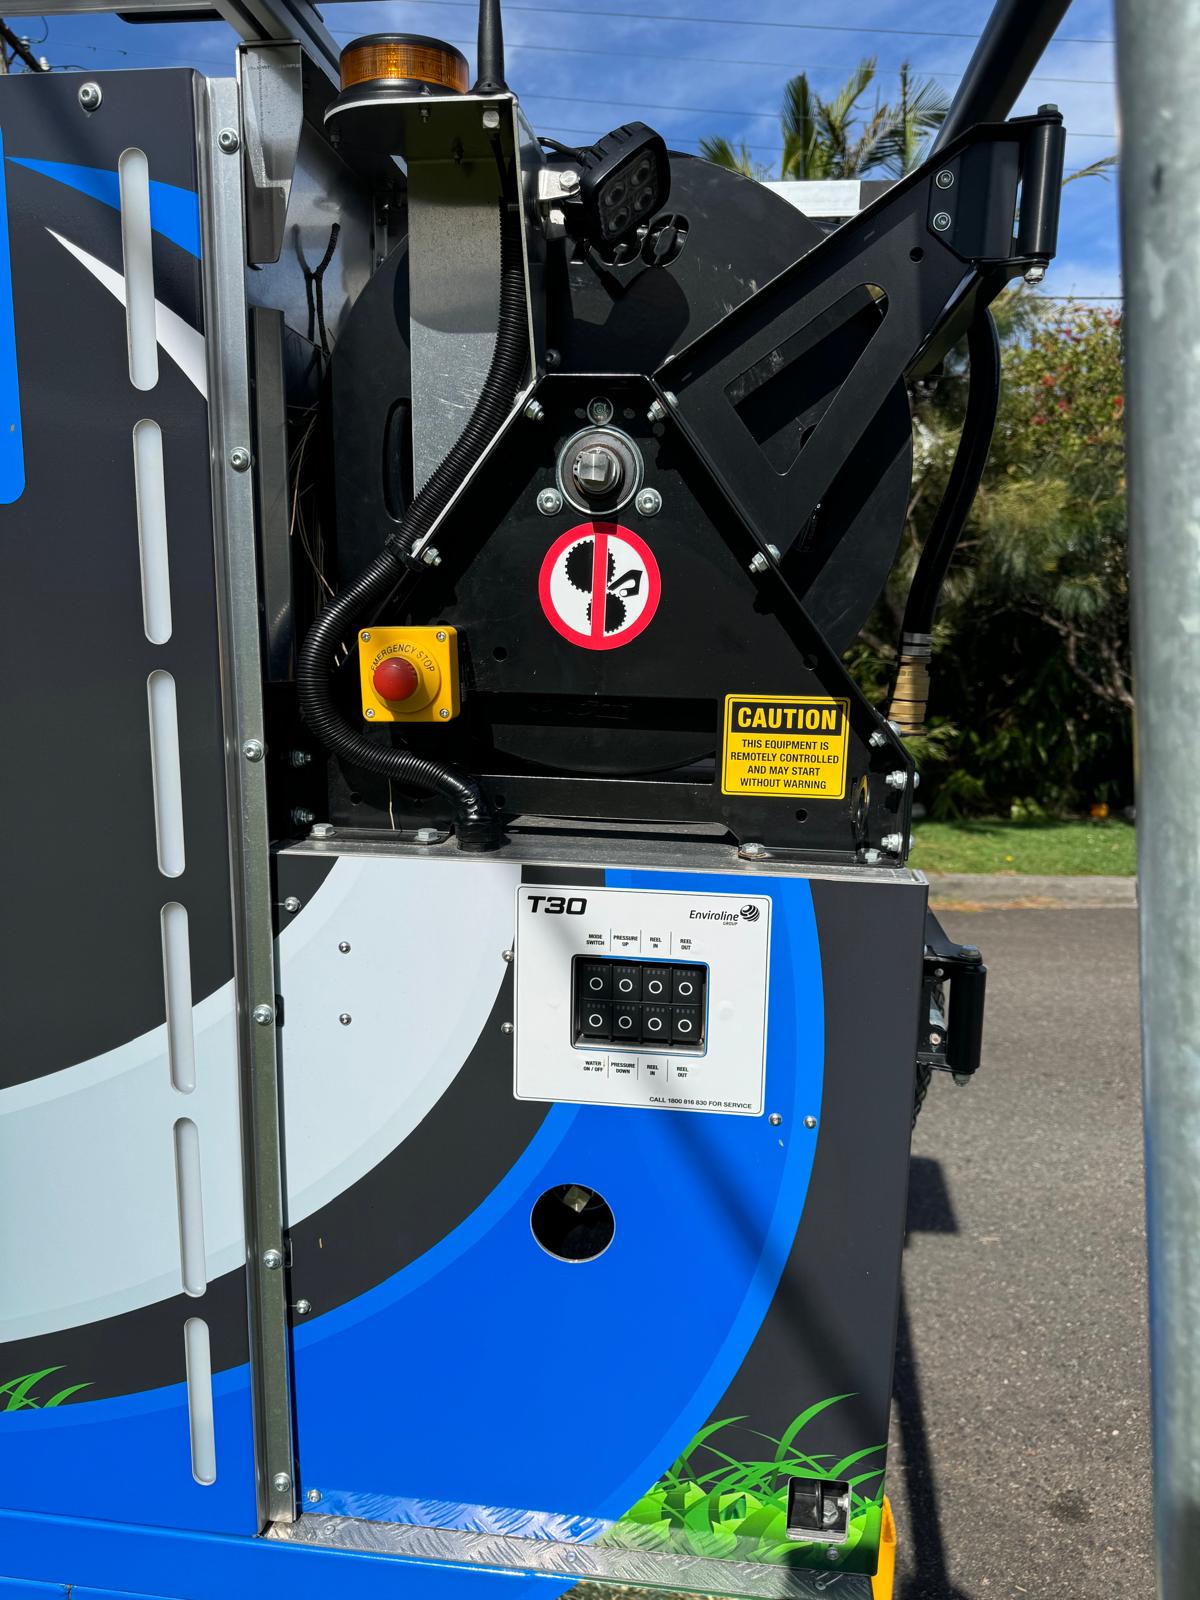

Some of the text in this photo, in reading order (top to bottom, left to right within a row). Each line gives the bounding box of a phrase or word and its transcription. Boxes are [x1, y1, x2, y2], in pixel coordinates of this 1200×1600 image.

[371, 644, 435, 672] EMERGENCY STOP
[737, 707, 837, 730] CAUTION
[742, 739, 829, 750] THIS EQUIPMENT IS
[730, 752, 839, 764] REMOTELY CONTROLLED
[747, 765, 821, 776] AND MAY START
[740, 778, 827, 789] WITHOUT WARNING
[527, 895, 588, 915] T30
[689, 909, 739, 921] Enviroline
